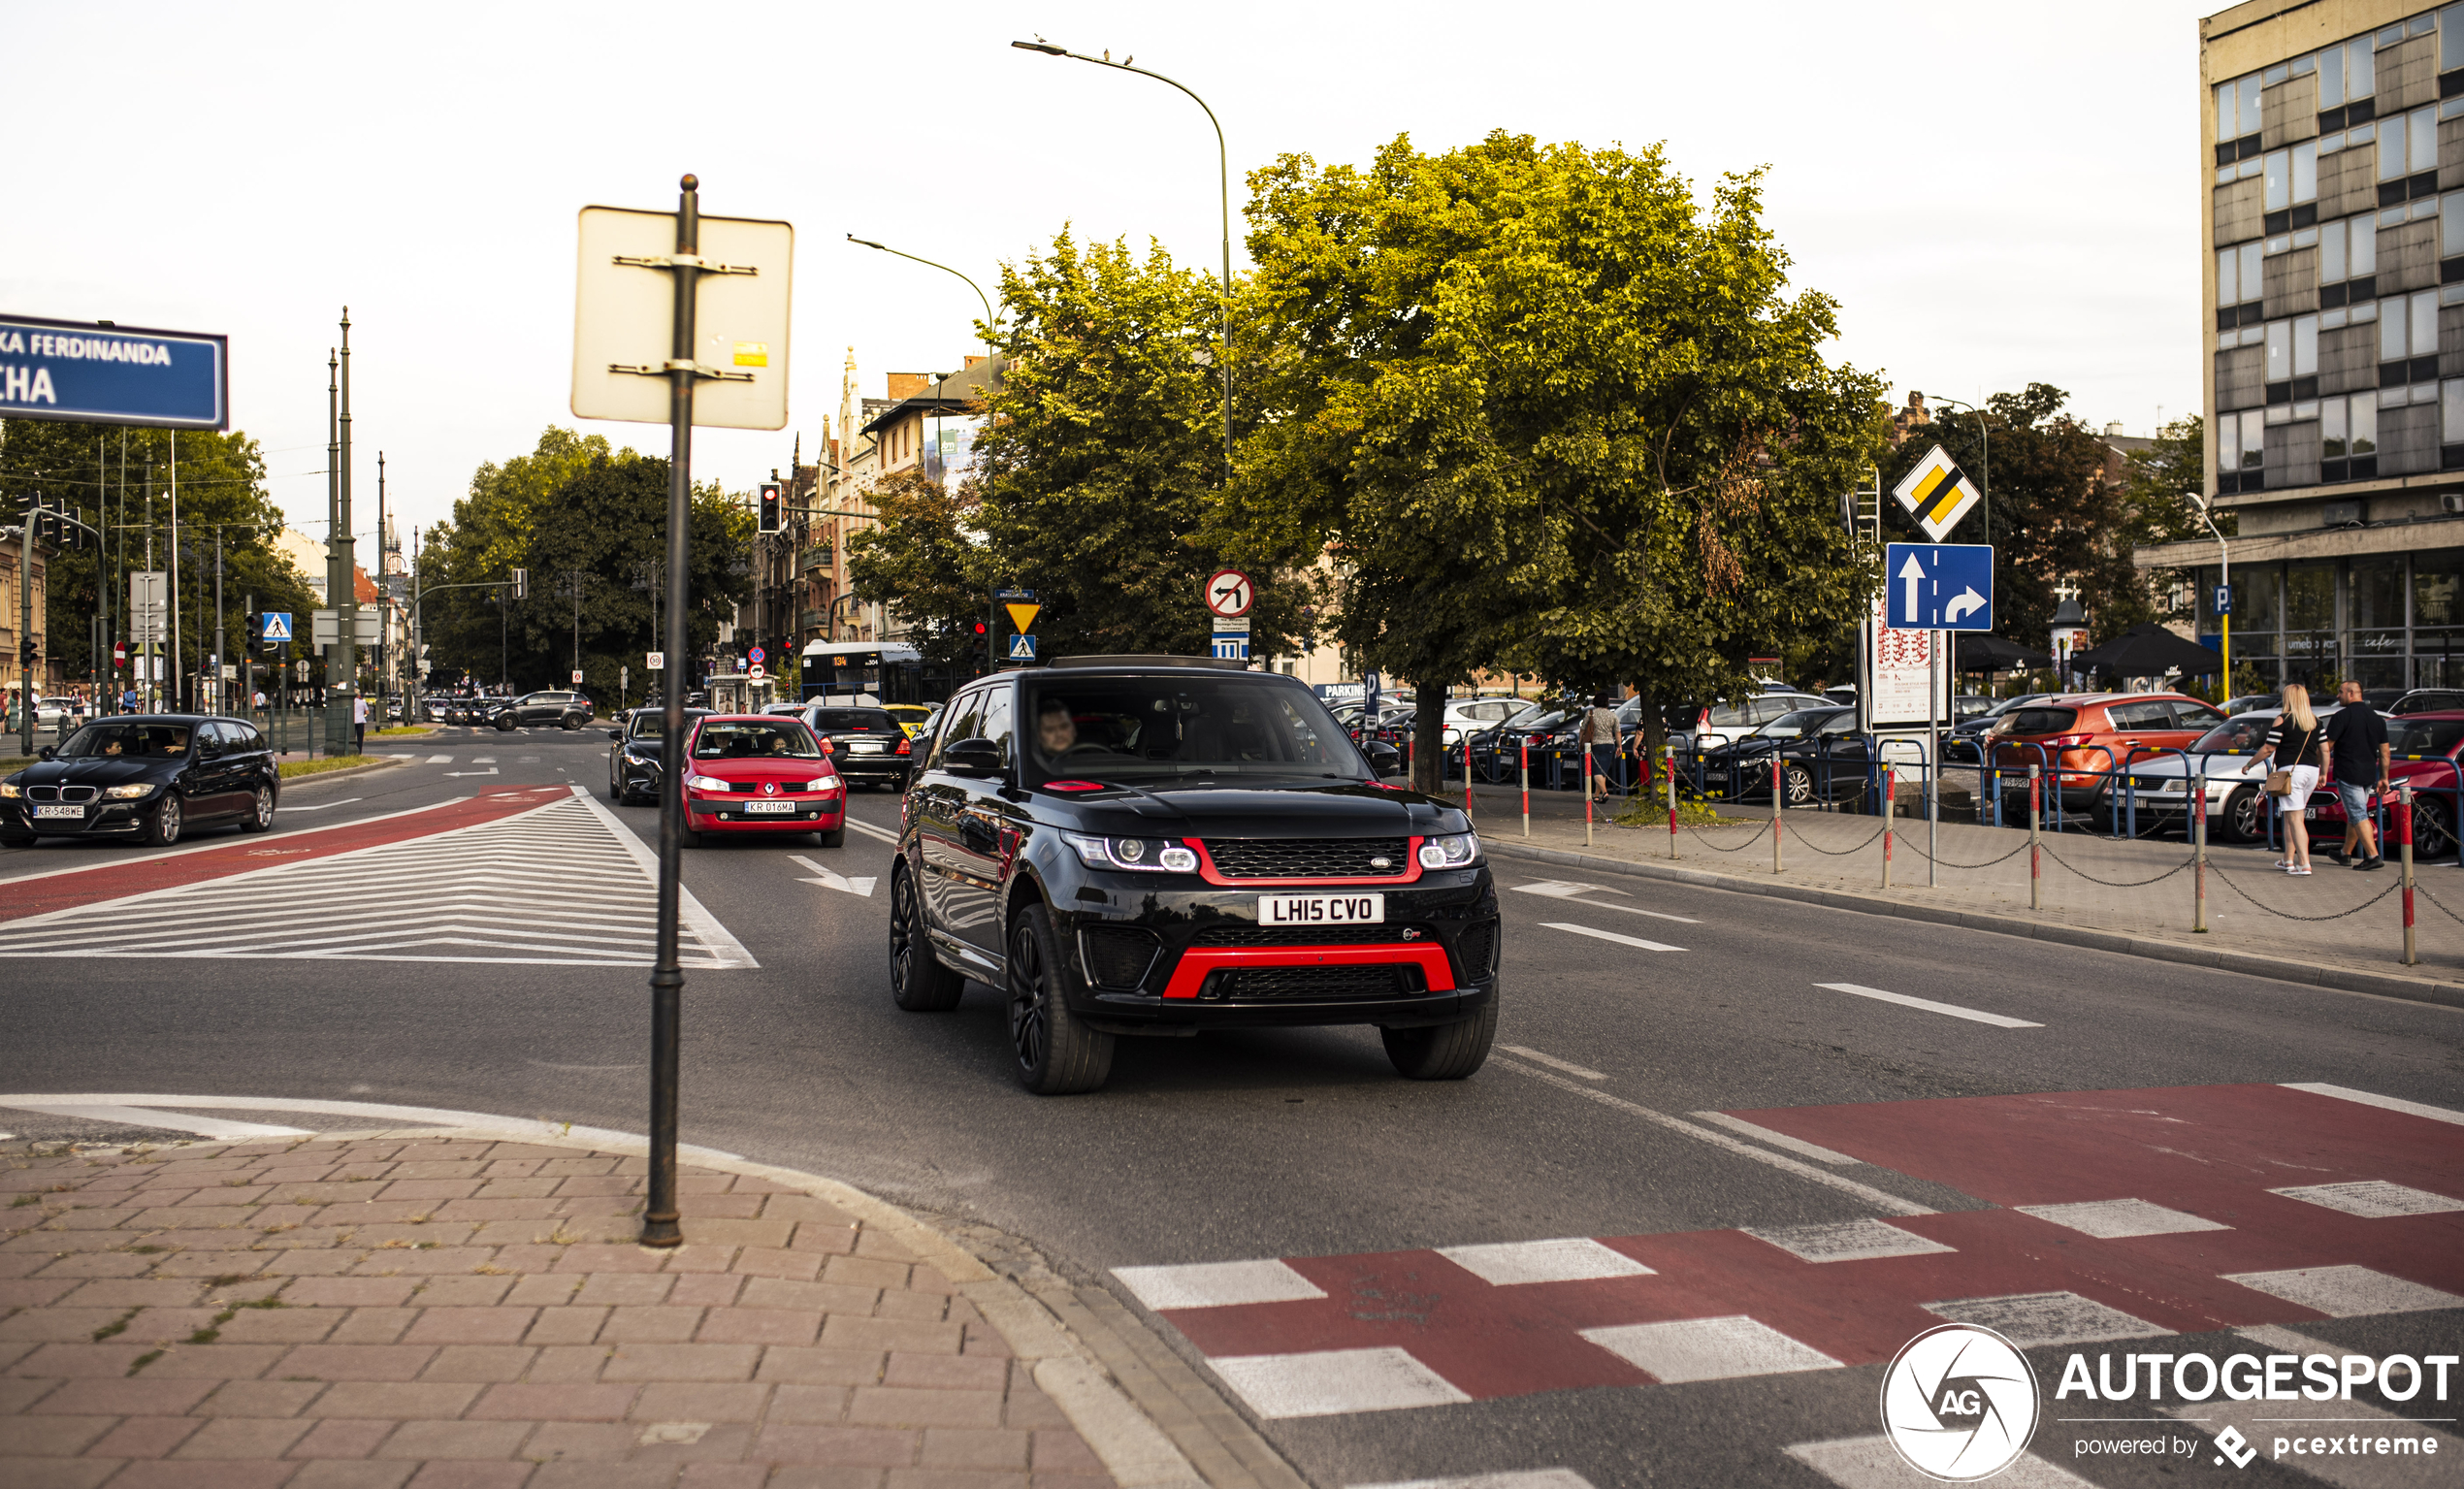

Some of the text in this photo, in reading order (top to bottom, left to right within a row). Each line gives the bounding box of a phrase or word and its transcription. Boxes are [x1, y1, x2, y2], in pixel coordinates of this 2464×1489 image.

[30, 334, 172, 366] FERDINANDA
[0, 365, 56, 404] HA
[2364, 632, 2395, 651] cafe
[833, 656, 847, 666] 134
[1325, 684, 1366, 697] PARKING
[39, 806, 82, 816] KR 548WE
[750, 802, 794, 812] KR 016MA
[1274, 898, 1372, 921] LH15 CVO
